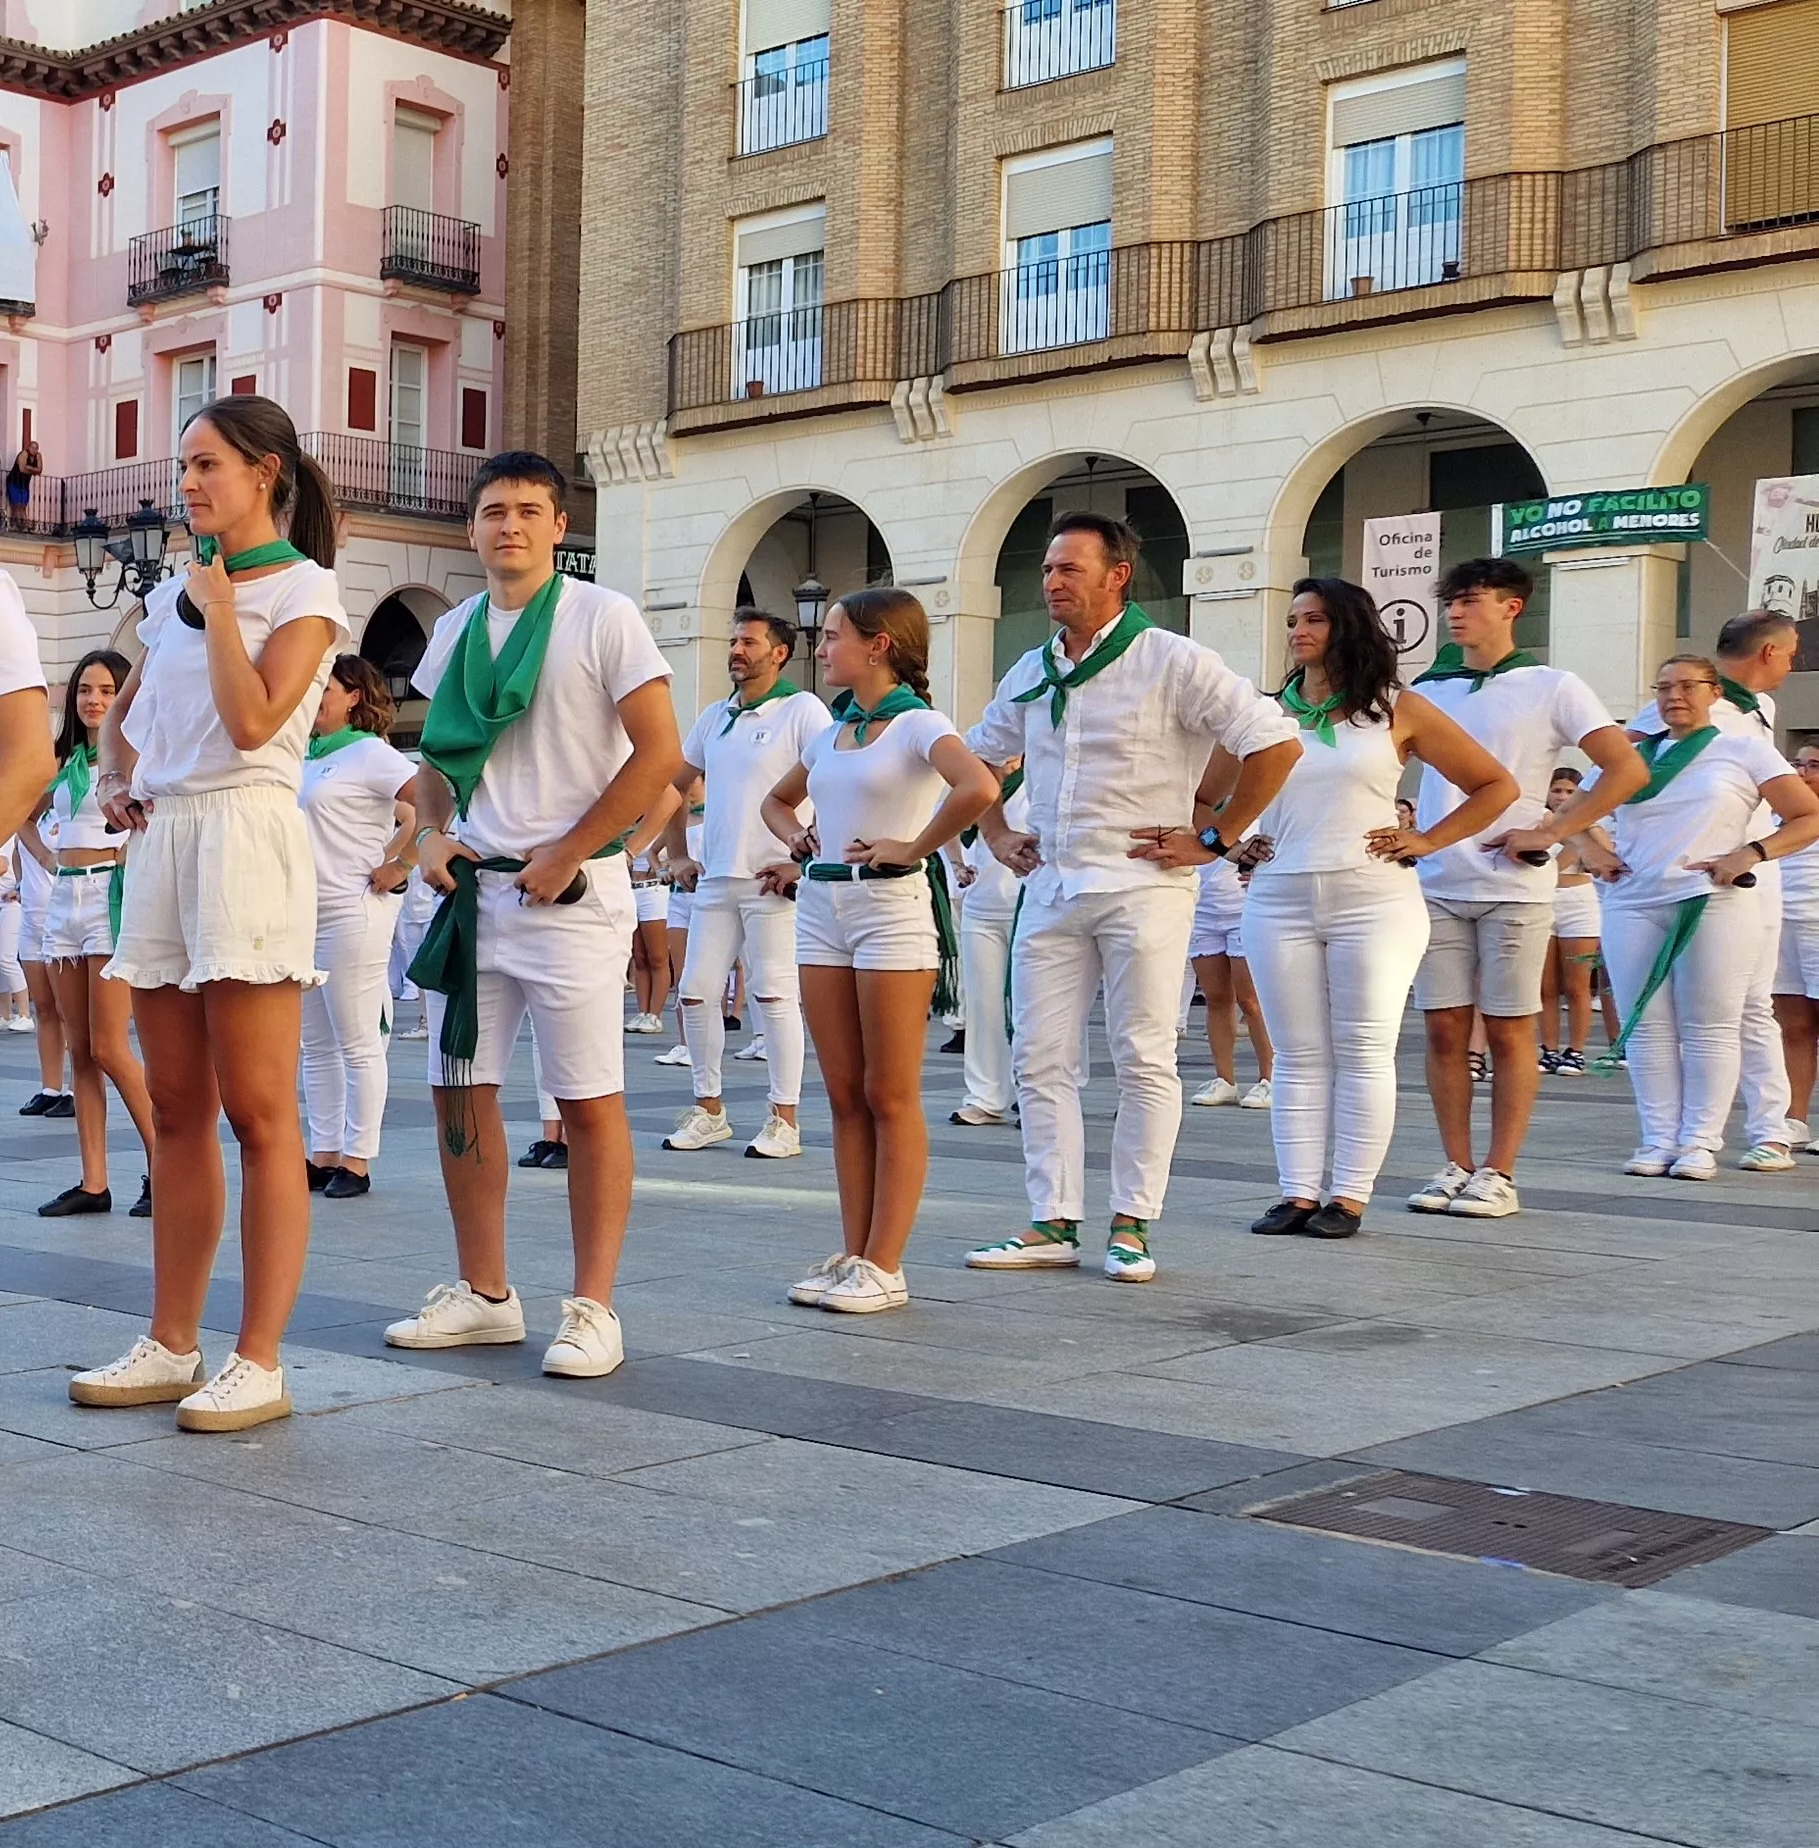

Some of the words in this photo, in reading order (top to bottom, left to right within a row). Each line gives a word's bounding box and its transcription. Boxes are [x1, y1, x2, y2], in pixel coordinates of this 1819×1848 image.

[1510, 505, 1544, 525] YO
[1547, 499, 1582, 519] NO
[1586, 489, 1702, 513] FACILITO
[1510, 518, 1594, 543] ALCOHOL
[1597, 516, 1609, 530] A
[1613, 512, 1701, 529] MENORES
[1379, 532, 1432, 547] Oficina
[1414, 547, 1432, 559] de
[1371, 565, 1432, 578] Turismo
